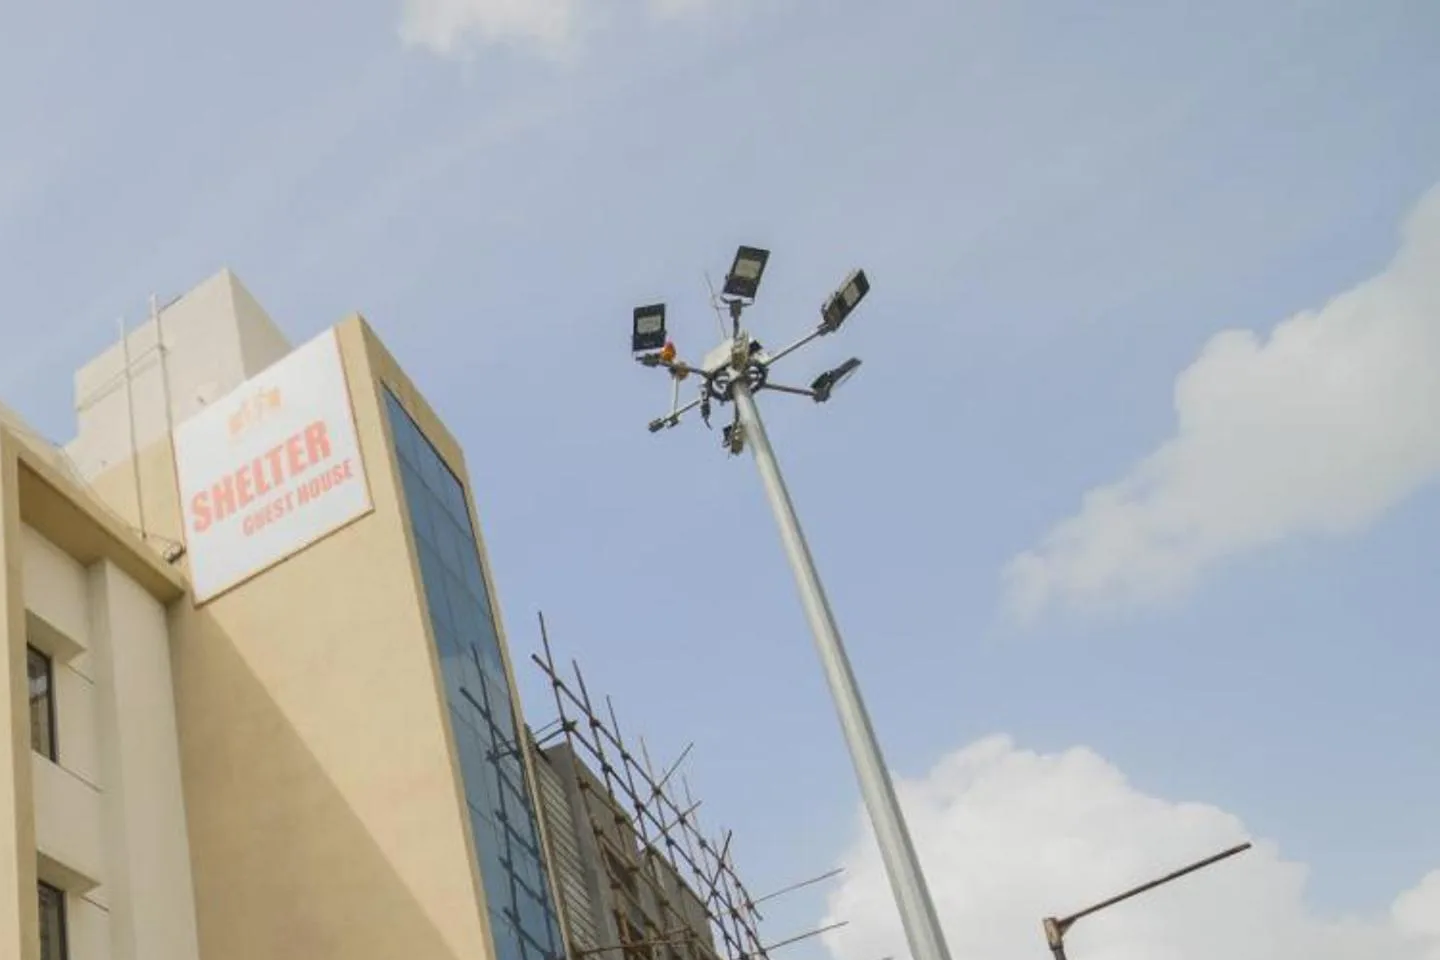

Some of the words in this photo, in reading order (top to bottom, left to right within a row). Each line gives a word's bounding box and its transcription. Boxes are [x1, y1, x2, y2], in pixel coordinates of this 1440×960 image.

[190, 420, 333, 532] SHELTER
[242, 494, 293, 536] GUEST
[297, 459, 353, 501] HOUSE
